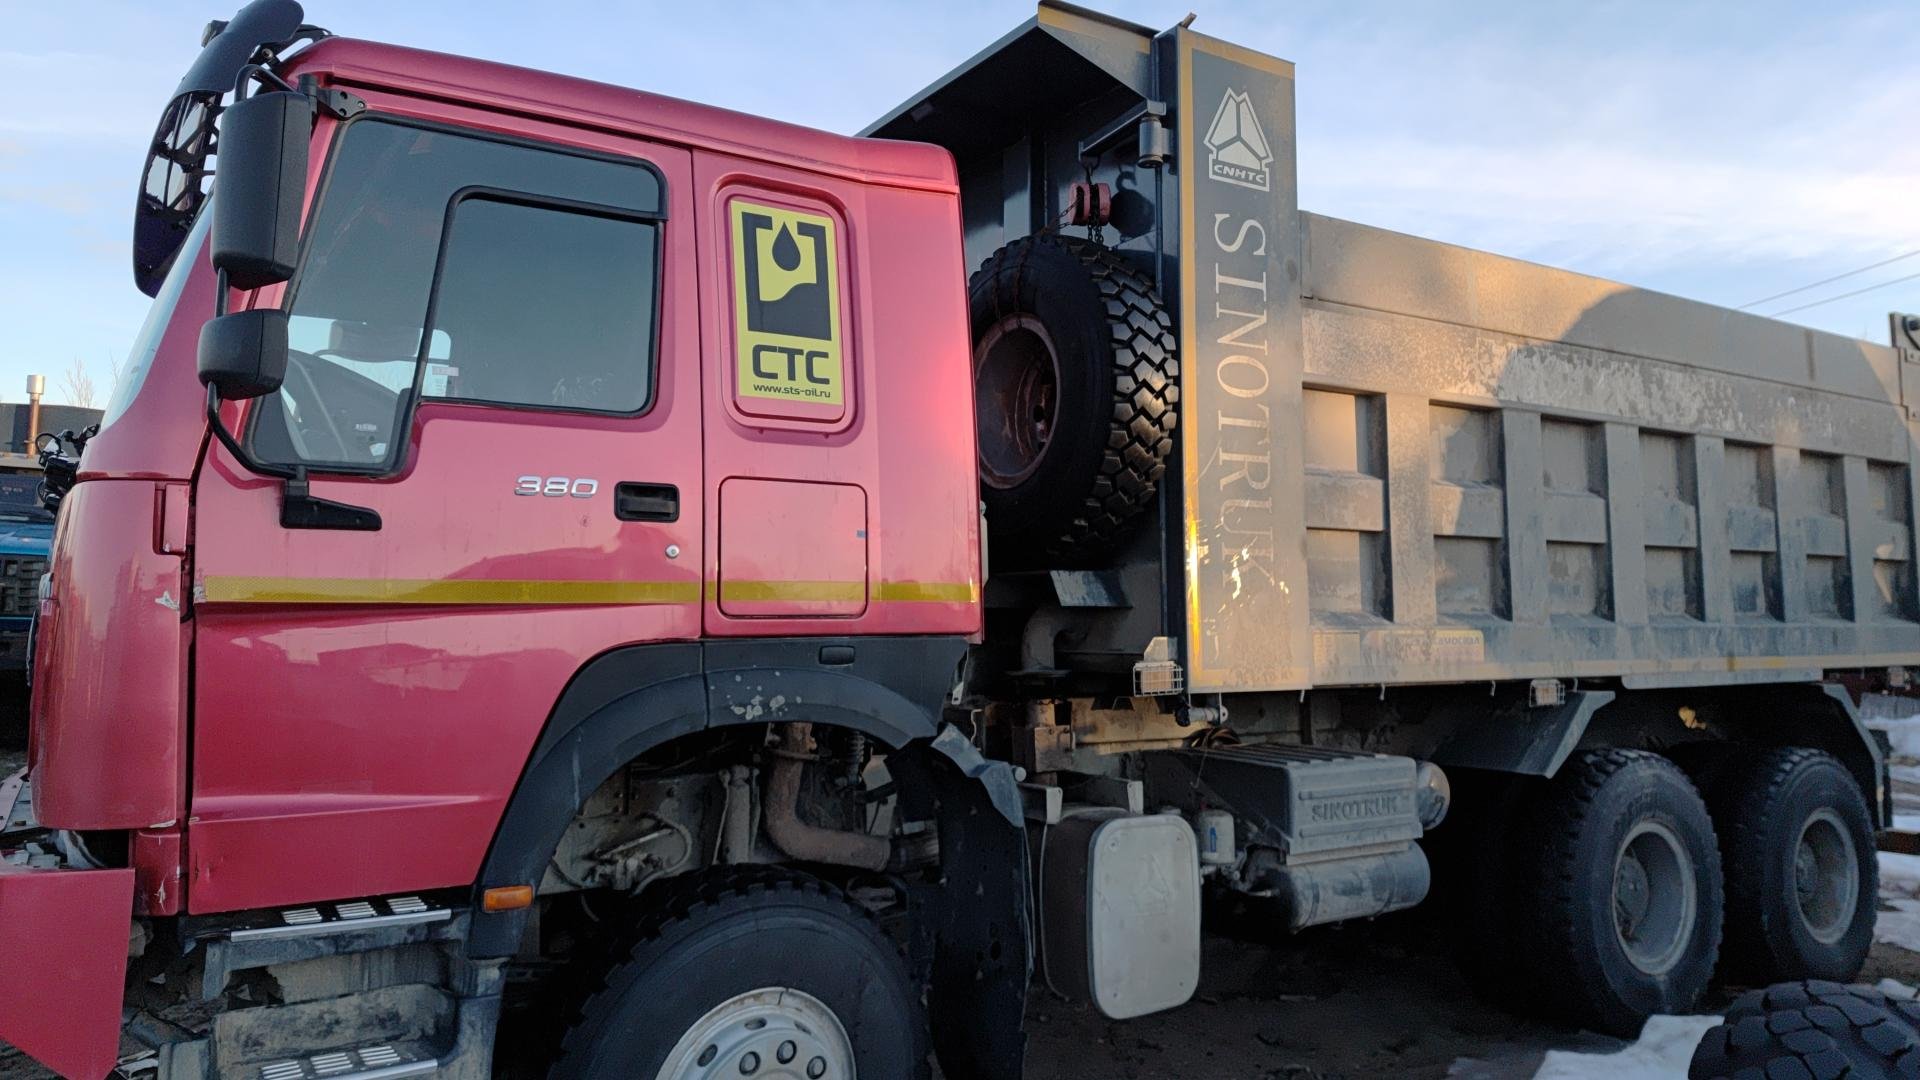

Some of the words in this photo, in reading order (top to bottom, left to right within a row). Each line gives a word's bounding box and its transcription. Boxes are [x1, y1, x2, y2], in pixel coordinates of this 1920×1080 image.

[1214, 164, 1265, 184] CNHTC
[753, 384, 831, 398] www.sts-oil.ru
[1214, 212, 1275, 589] SINOTRUK
[514, 475, 599, 498] 380
